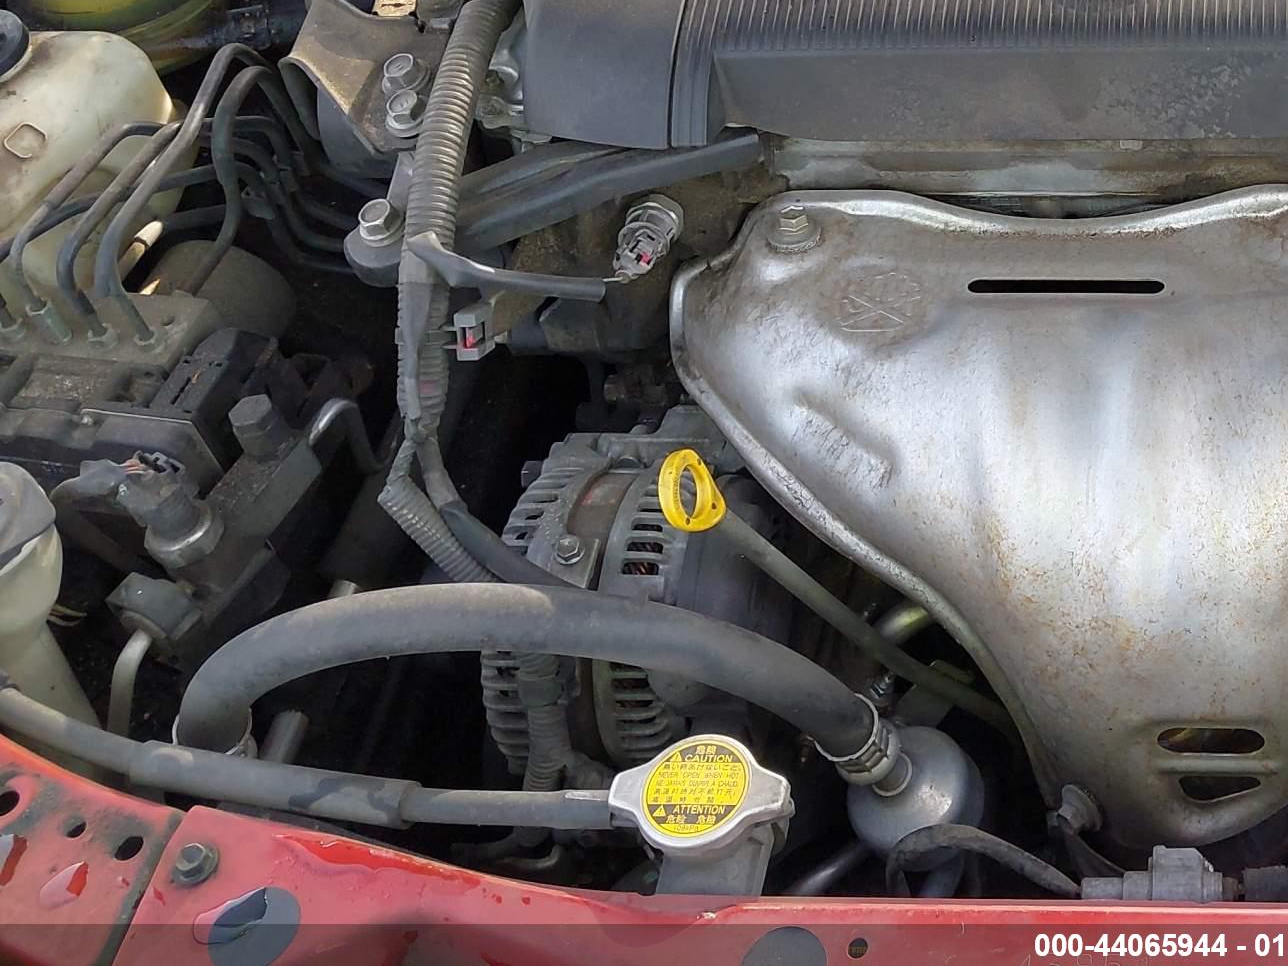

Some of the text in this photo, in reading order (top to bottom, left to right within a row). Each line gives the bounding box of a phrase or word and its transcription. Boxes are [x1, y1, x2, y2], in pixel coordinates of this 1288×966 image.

[684, 754, 733, 763] CAUTION
[659, 771, 679, 779] NEVER
[672, 805, 726, 814] ATTENTION
